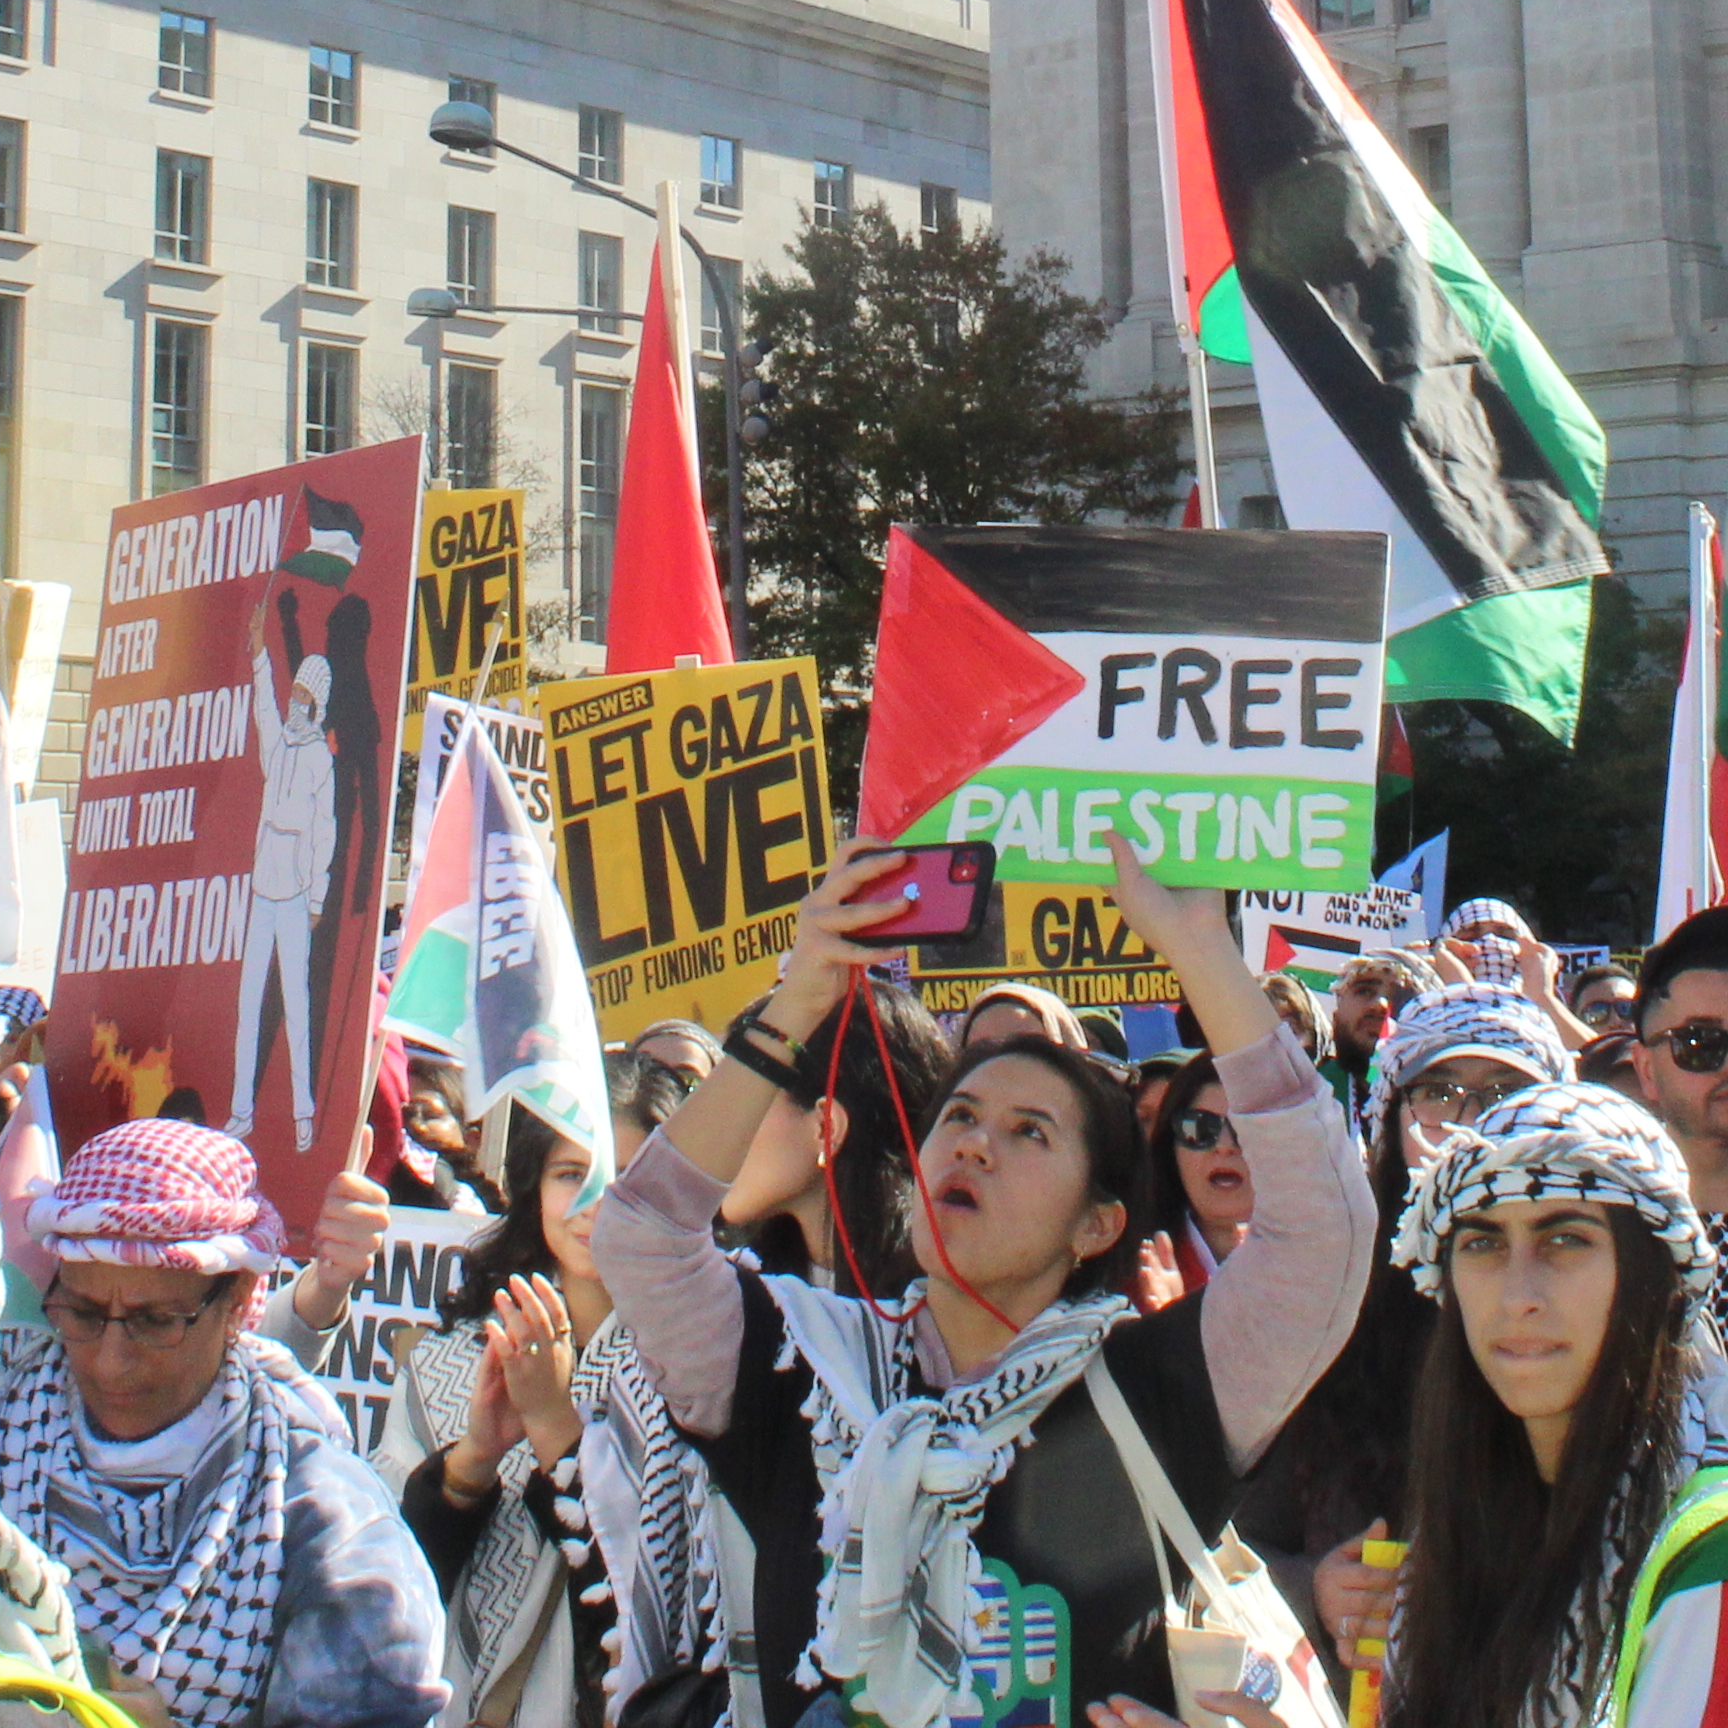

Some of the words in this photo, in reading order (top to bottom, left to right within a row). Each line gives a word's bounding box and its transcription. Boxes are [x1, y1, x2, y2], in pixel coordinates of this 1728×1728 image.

[108, 493, 284, 605] GENERATION
[430, 499, 518, 568] GAZA
[97, 618, 159, 680] AFTER
[87, 683, 252, 779] GENERATION
[556, 682, 650, 735] ANSWER
[1097, 646, 1364, 750] FREE
[555, 718, 653, 819] LET
[669, 672, 814, 780] GAZA
[76, 794, 133, 855] UNTIL
[137, 786, 196, 848] TOTAL
[563, 745, 829, 969] LIVE!
[946, 783, 1350, 870] PALESTINE
[60, 871, 253, 975] LIBERATION
[1324, 910, 1352, 924] OUR
[1326, 895, 1359, 912] AND
[1374, 886, 1412, 906] NAME
[589, 964, 634, 1010] TOP
[643, 936, 726, 993] FUNDING
